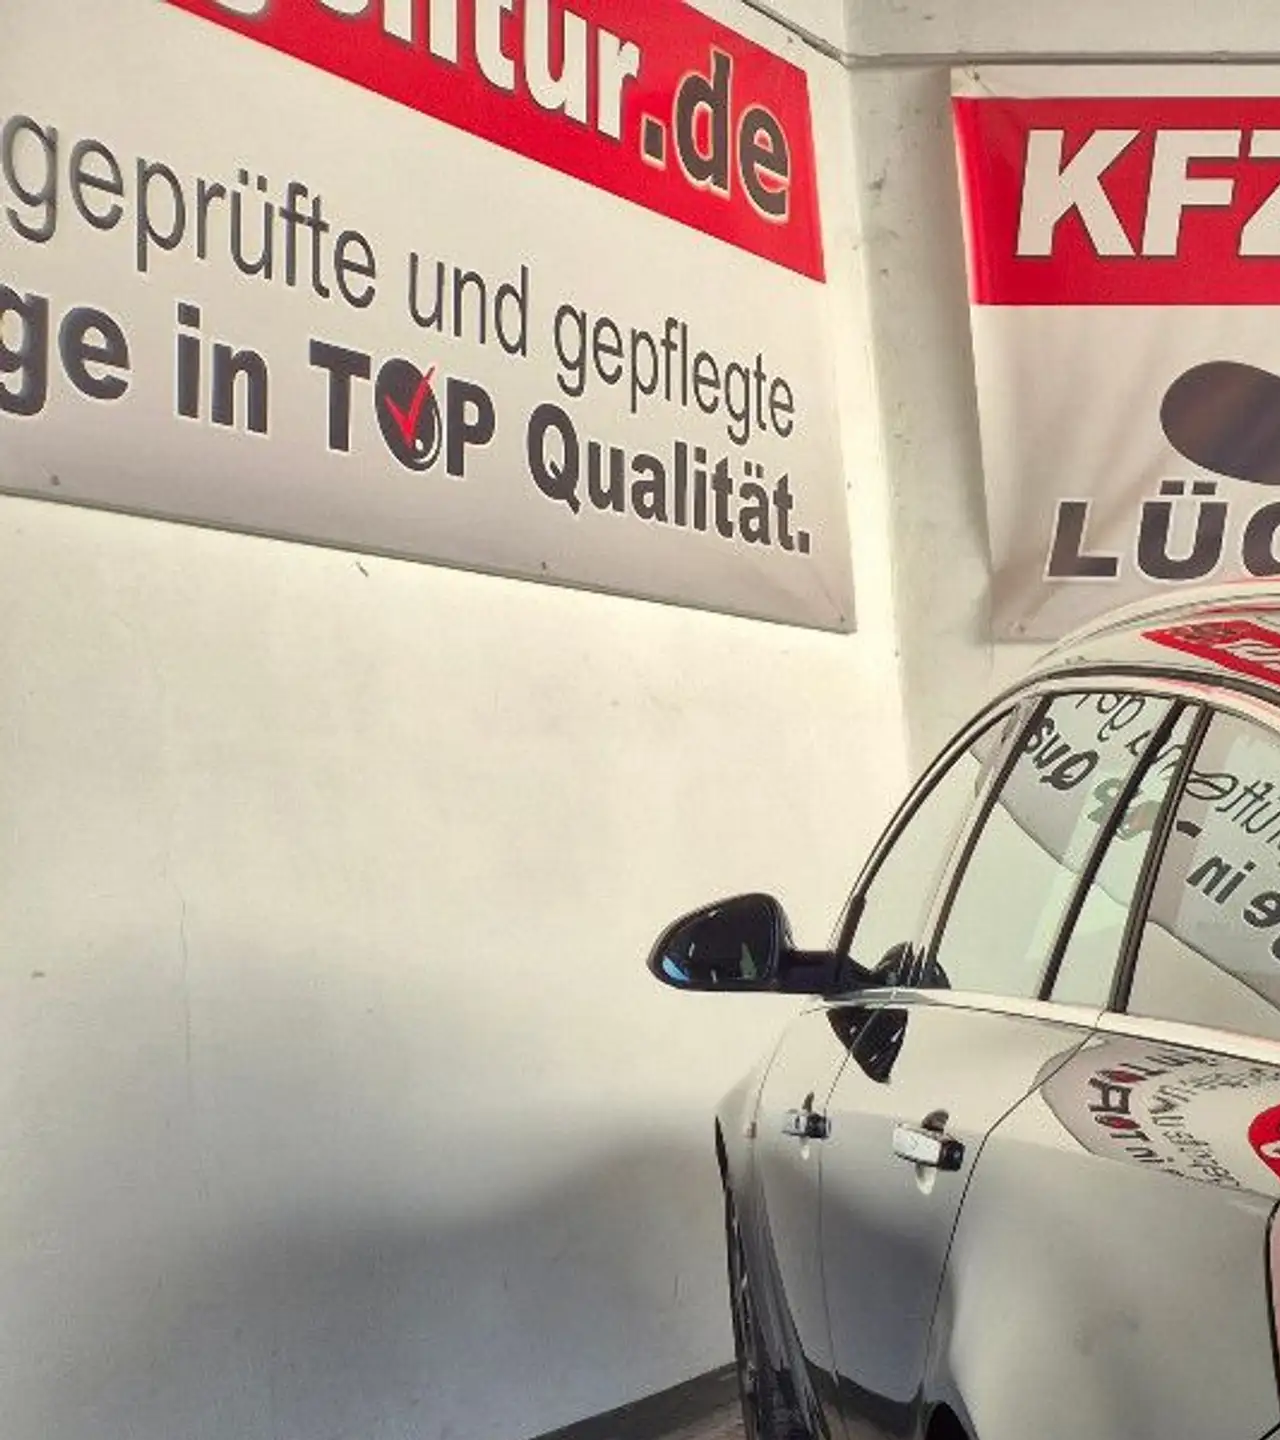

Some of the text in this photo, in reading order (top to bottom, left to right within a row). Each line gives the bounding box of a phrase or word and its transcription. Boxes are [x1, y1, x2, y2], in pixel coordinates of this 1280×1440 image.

[176, 303, 268, 434] in
[309, 339, 496, 476] TOP
[527, 402, 811, 555] Qualität.
[409, 251, 528, 357] und
[554, 303, 796, 447] gepflegte
